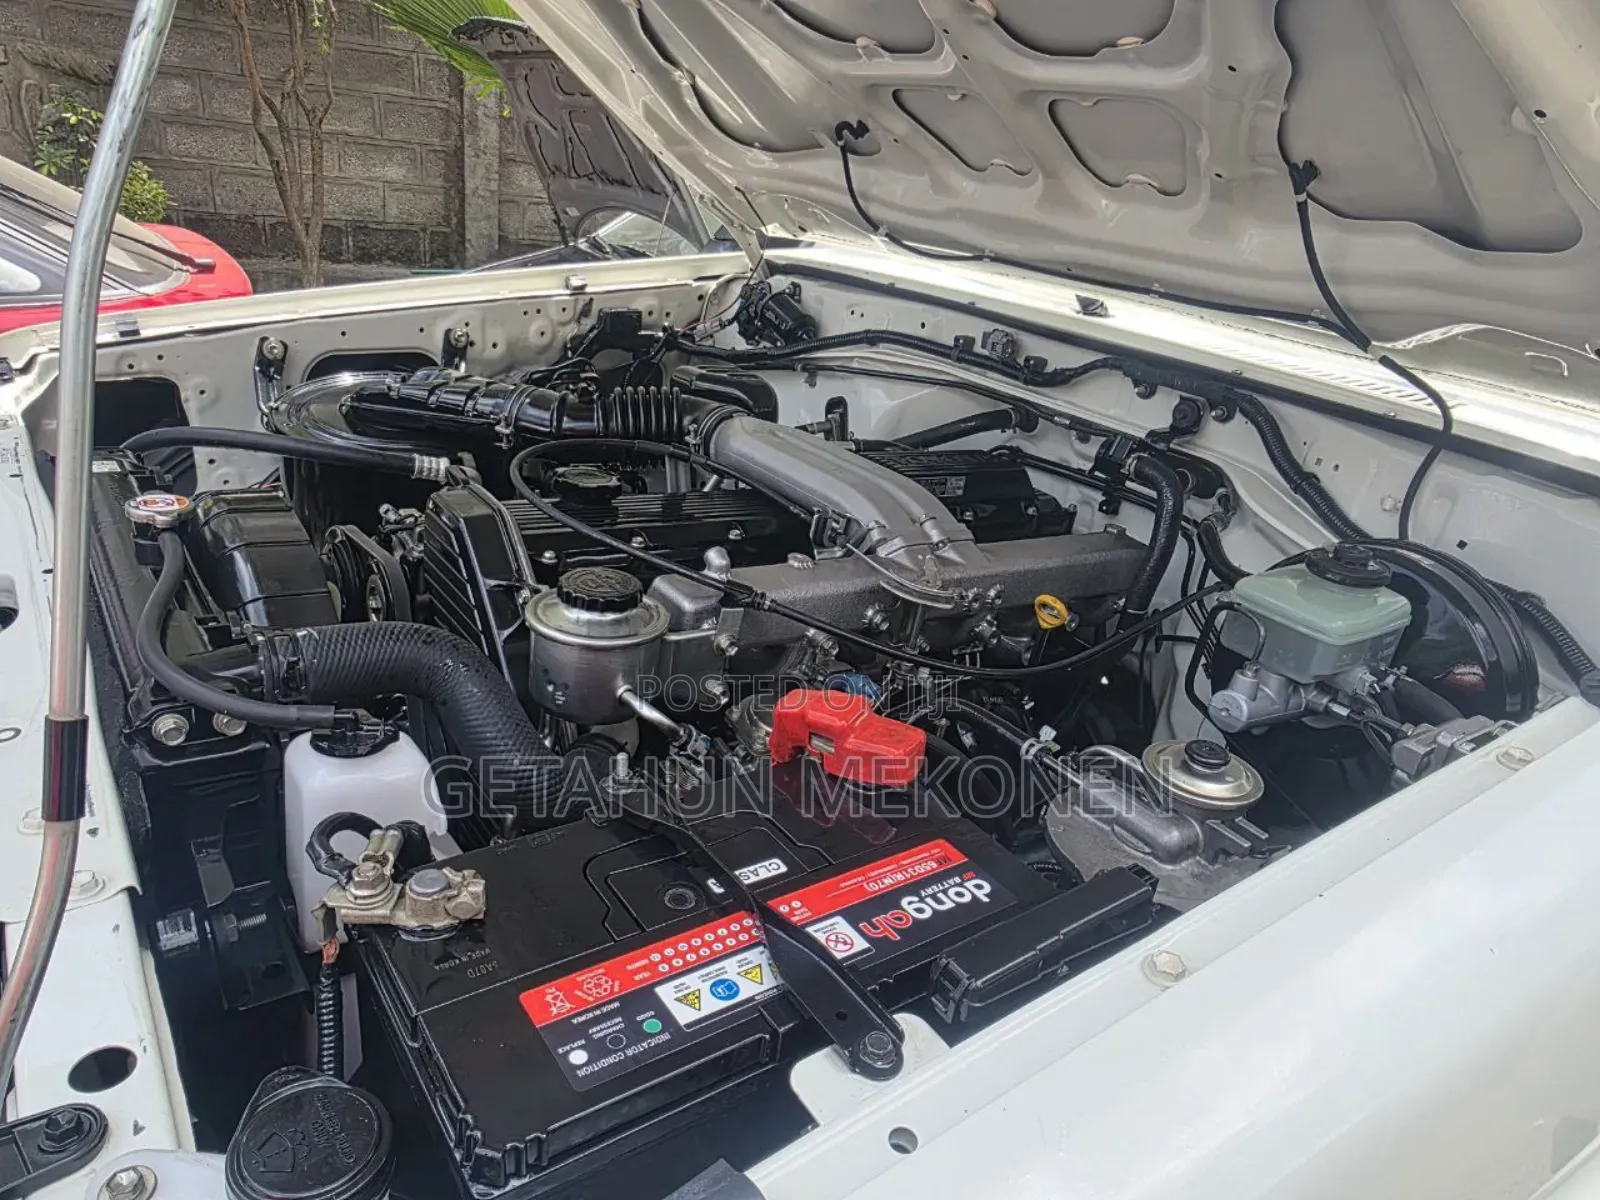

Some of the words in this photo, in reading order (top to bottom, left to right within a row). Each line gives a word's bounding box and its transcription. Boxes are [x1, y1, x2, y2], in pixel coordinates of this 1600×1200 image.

[737, 860, 781, 882] CLAS
[863, 860, 938, 892] 65D31R(N70)
[920, 875, 962, 898] BATTERY
[858, 878, 992, 942] dongah
[626, 1032, 671, 1058] INDICATOR
[576, 1051, 626, 1078] CONDITION
